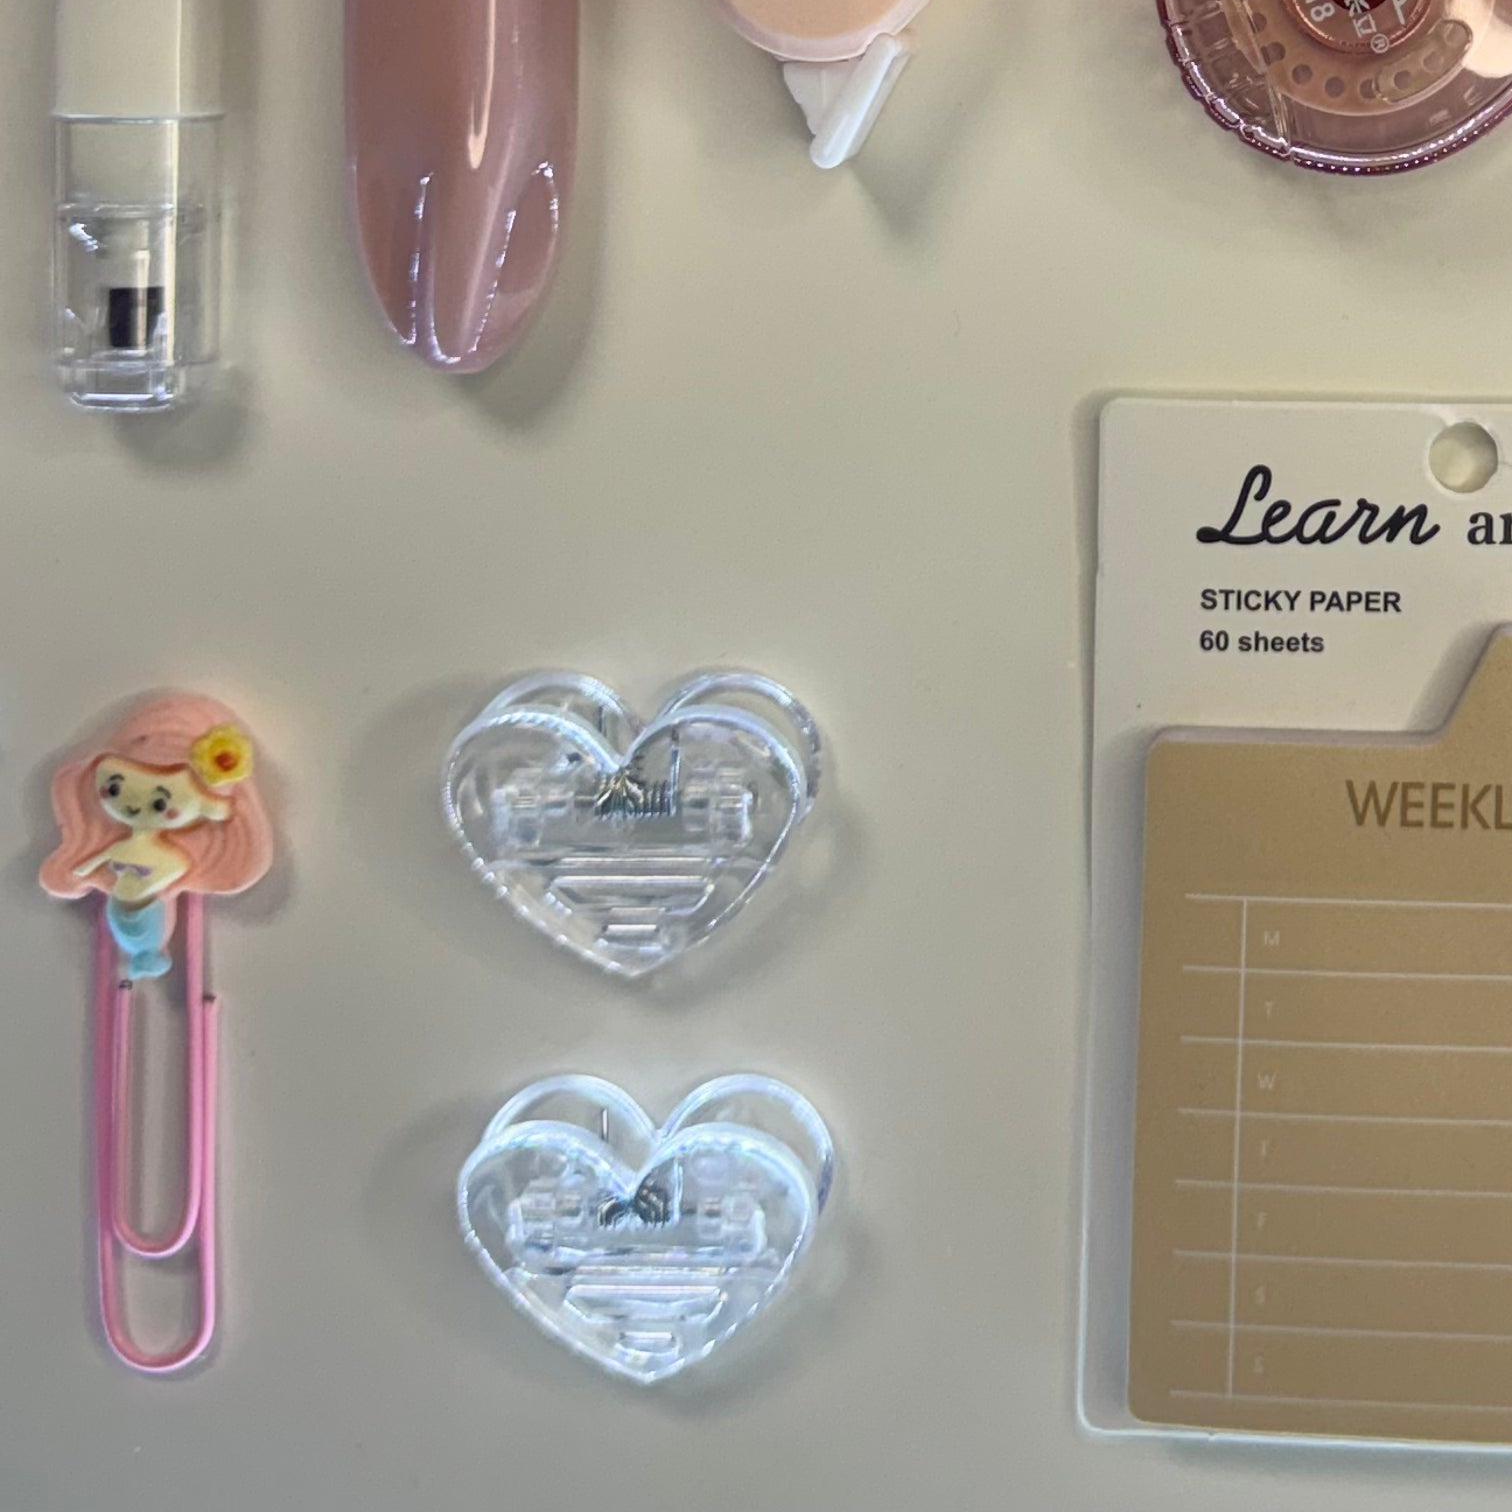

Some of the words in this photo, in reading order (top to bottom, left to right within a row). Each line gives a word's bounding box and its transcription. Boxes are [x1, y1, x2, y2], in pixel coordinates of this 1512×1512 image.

[1196, 464, 1441, 545] Learn
[1199, 588, 1301, 613] STICKY
[1309, 590, 1402, 614] PAPER
[1199, 631, 1230, 654] 60
[1237, 632, 1325, 655] sheets
[1262, 930, 1280, 947] M
[1257, 1073, 1276, 1090] W
